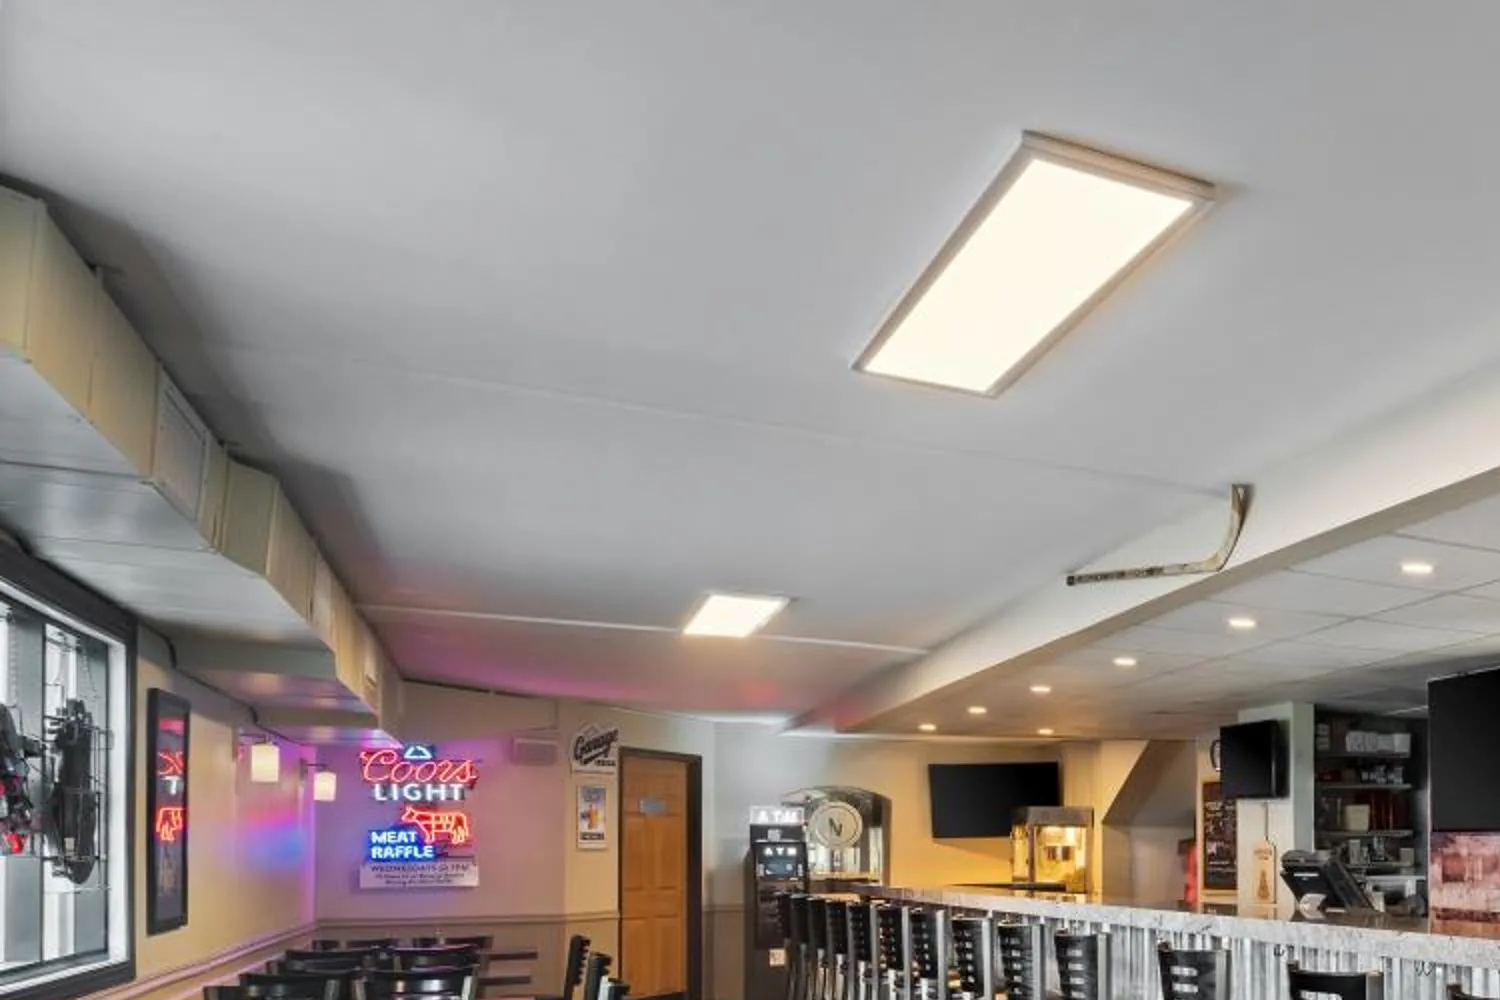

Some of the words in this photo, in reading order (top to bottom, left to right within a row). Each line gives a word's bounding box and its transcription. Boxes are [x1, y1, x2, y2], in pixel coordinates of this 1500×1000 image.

[360, 749, 478, 783] Coors
[374, 783, 464, 801] LIGHT
[757, 811, 800, 823] ATM
[371, 831, 418, 843] MEAT
[371, 845, 434, 859] RAFFLE
